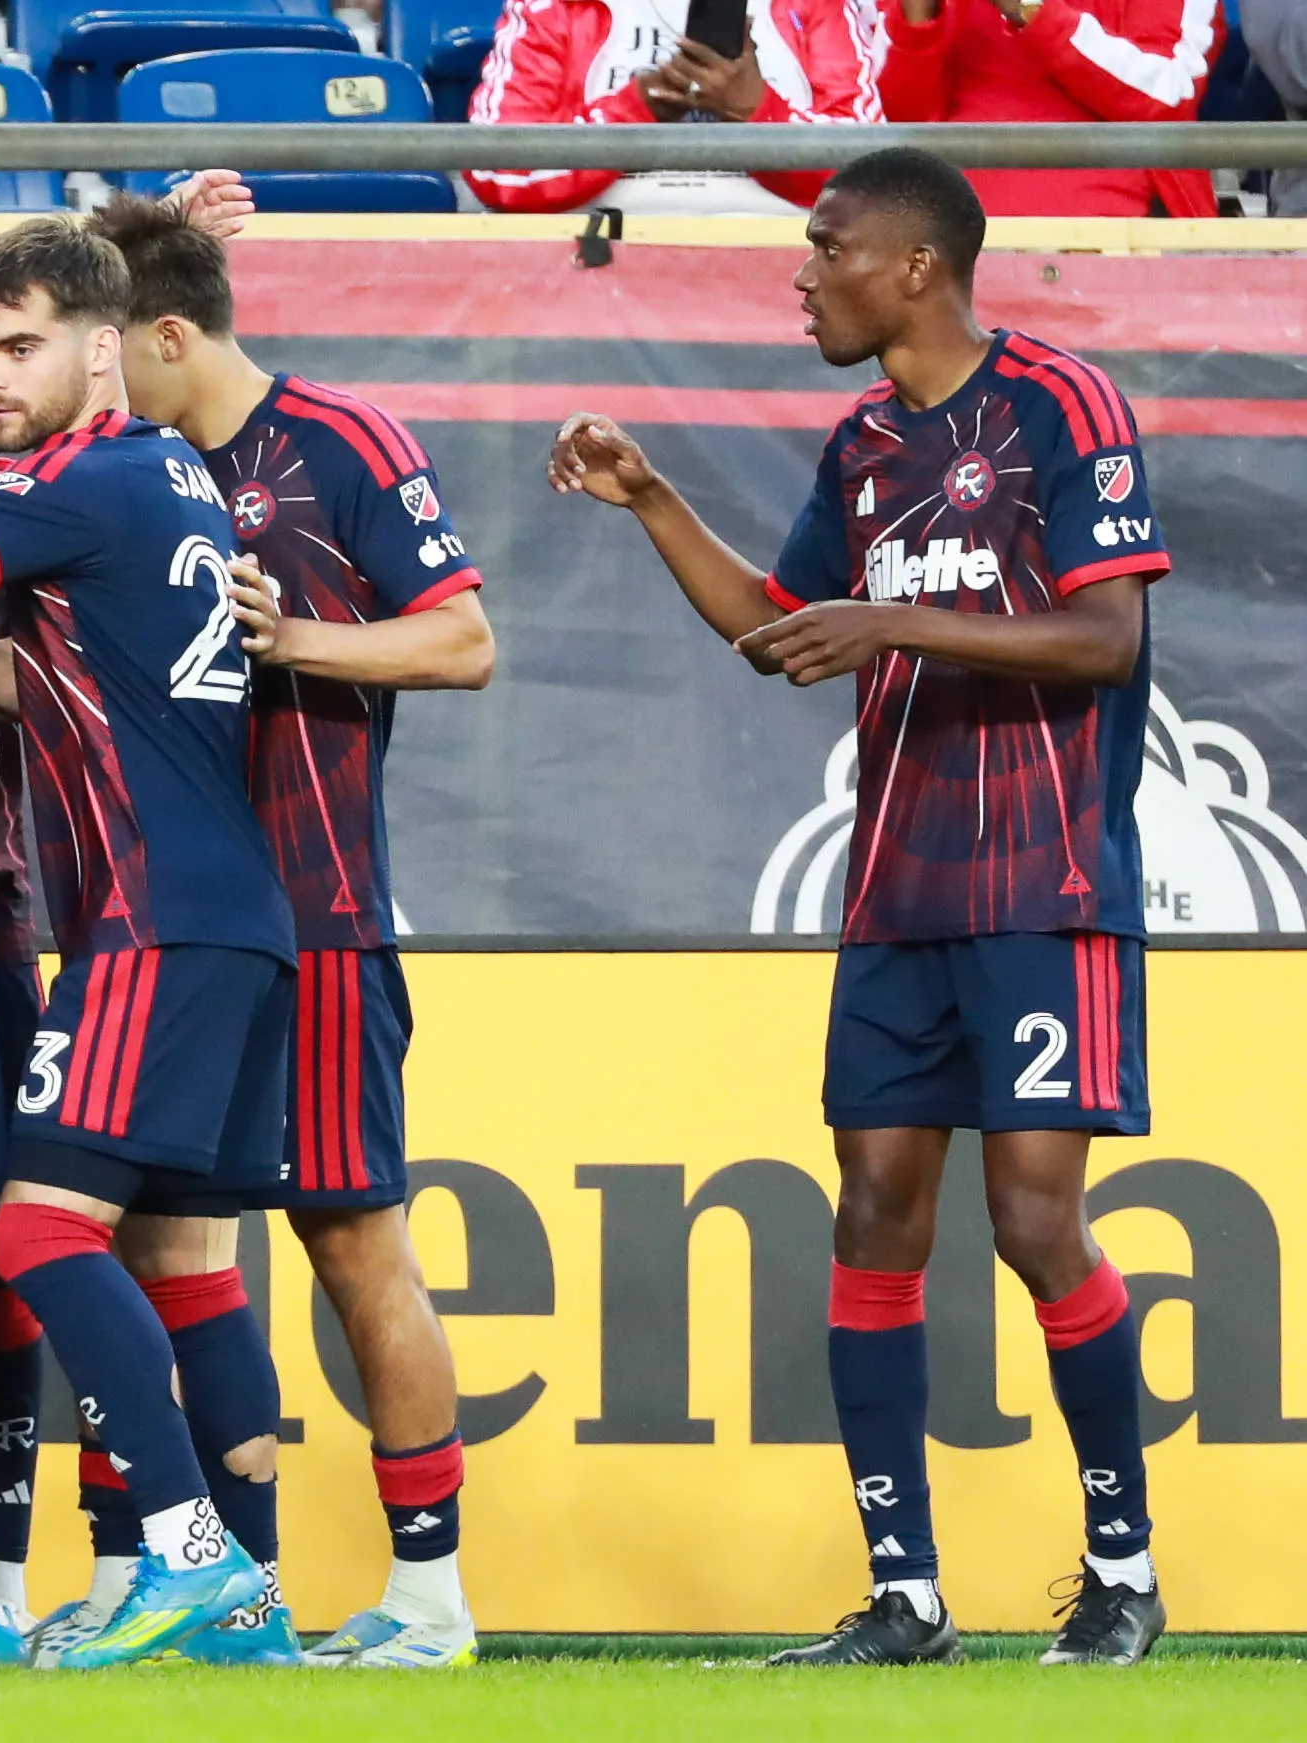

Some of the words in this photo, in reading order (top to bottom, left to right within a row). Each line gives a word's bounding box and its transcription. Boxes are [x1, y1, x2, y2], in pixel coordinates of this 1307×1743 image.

[327, 79, 357, 98] 12
[165, 457, 228, 513] SAN
[1097, 461, 1117, 473] MLS
[439, 532, 466, 557] tv
[1117, 516, 1152, 542] tv
[865, 538, 999, 602] Gillette
[167, 534, 252, 704] 2
[1143, 880, 1193, 921] HE
[1013, 1012, 1072, 1099] 2
